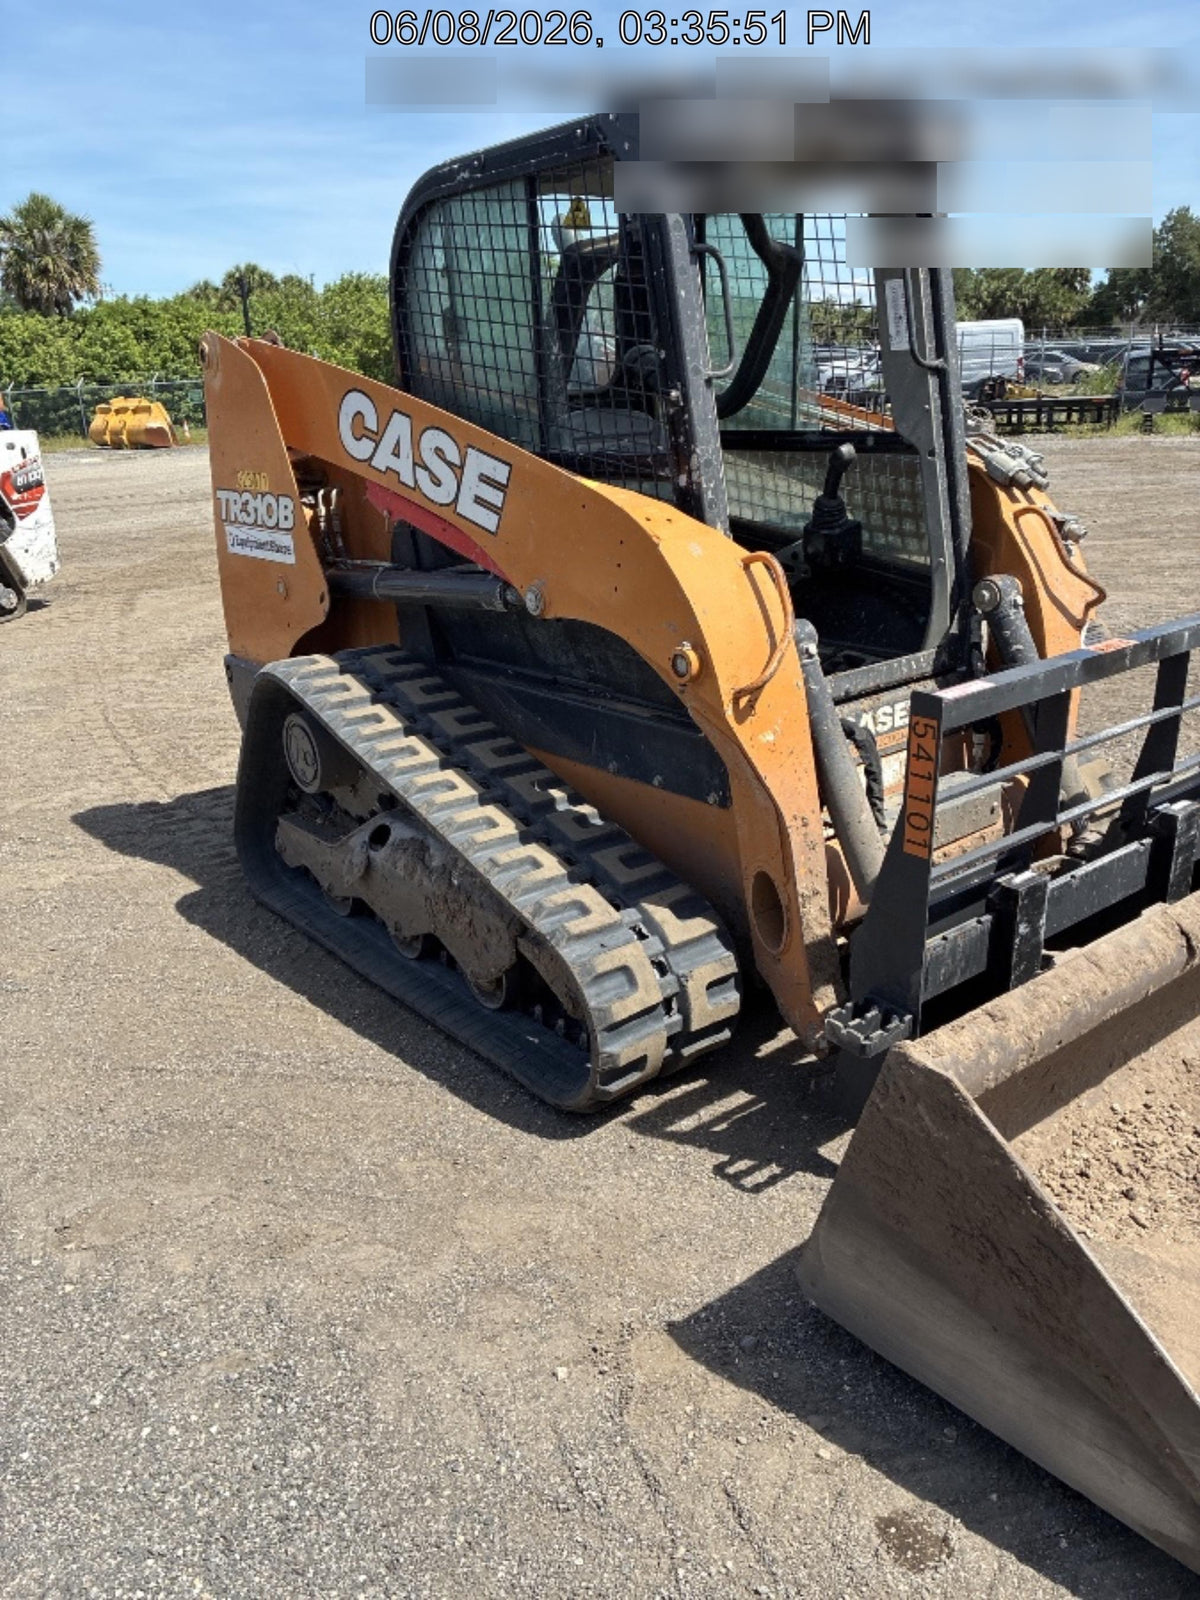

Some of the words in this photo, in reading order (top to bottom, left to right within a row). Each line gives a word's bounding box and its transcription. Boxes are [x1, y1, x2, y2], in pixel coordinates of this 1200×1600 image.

[338, 388, 512, 536] CASE
[216, 488, 296, 531] TR310B
[848, 700, 911, 735] ASE
[906, 720, 936, 850] 541101
